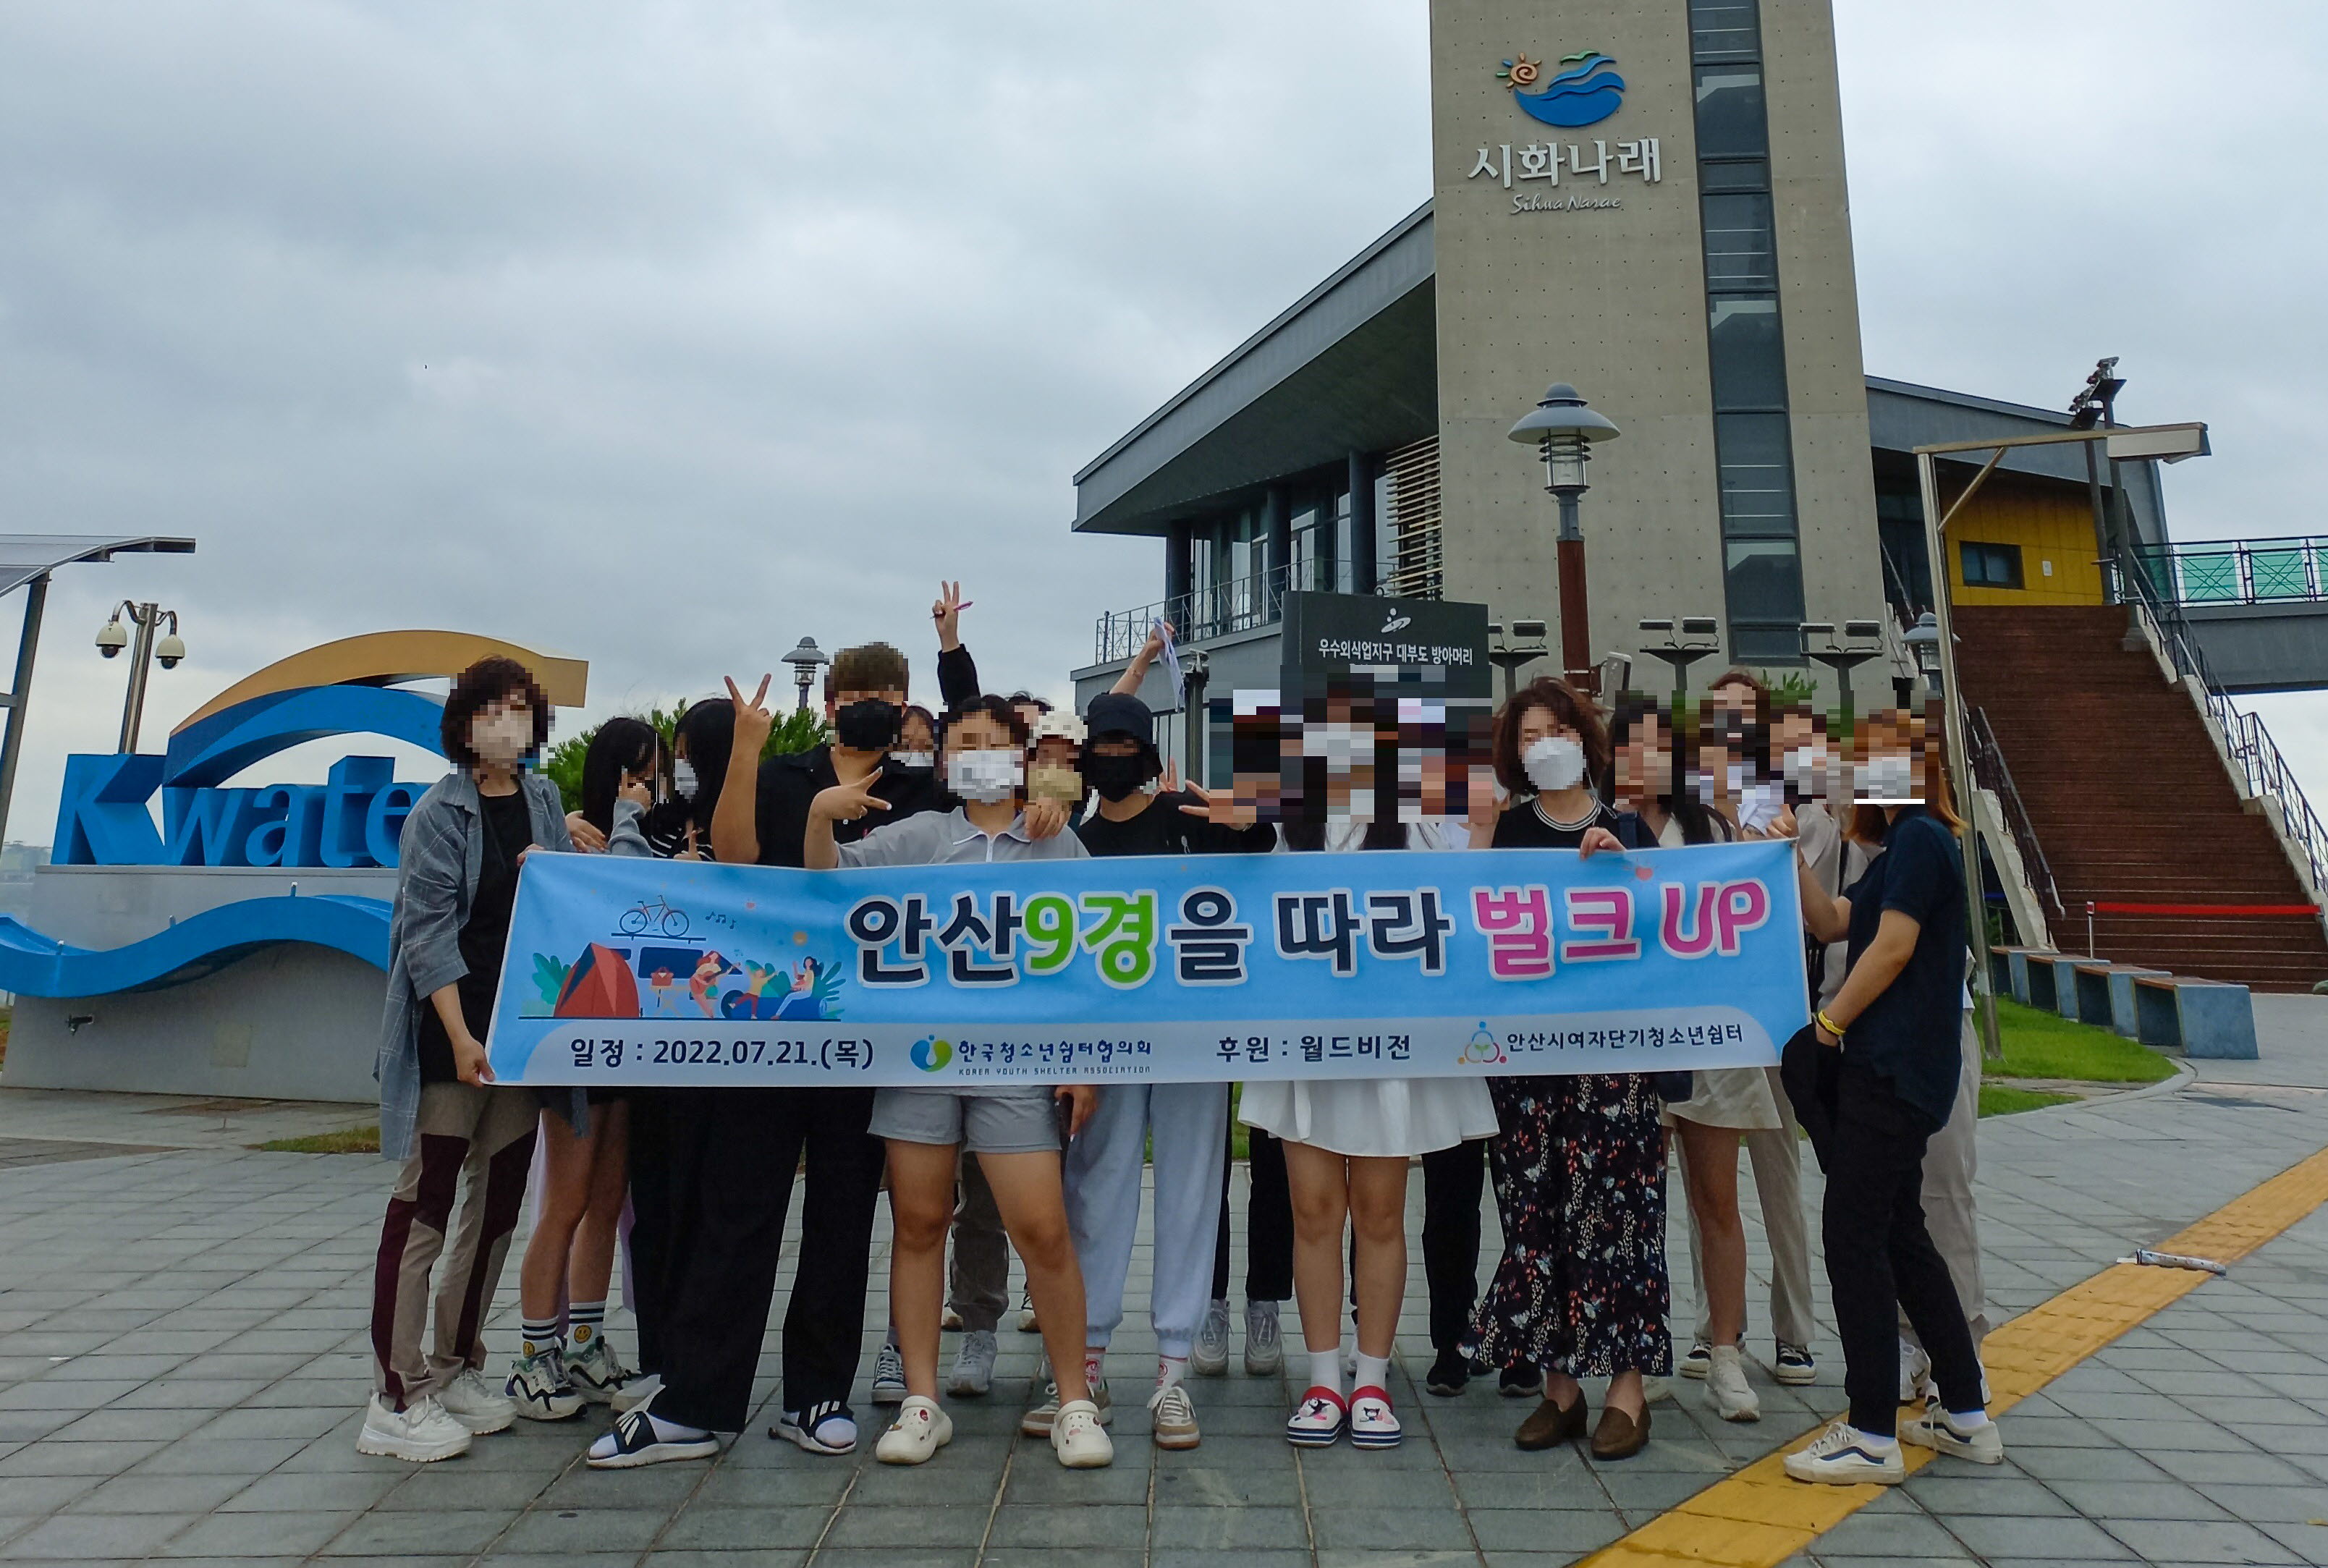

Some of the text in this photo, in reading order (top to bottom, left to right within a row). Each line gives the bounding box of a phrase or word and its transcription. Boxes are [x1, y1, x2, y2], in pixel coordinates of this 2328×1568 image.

[1468, 137, 1662, 190] 시화나래
[1510, 193, 1621, 215] Sihwa Narae
[1319, 638, 1473, 665] 우수외식업지구 대부도 방아머리
[51, 754, 436, 868] Kwate
[1272, 887, 1456, 977] 따라
[1472, 886, 1641, 980] 벌크
[1661, 878, 1770, 958] UP
[958, 1039, 1153, 1064] 한국청소년쉼터협의회
[1216, 1035, 1270, 1063] 후원
[1300, 1034, 1411, 1062] 월드비전
[1507, 1022, 1743, 1053] 안산시여자단기청소년쉼터
[570, 1038, 626, 1068] 일정
[652, 1038, 875, 1070] 2022.07.21.(목)
[996, 1067, 1028, 1076] YOUTH
[1034, 1067, 1078, 1076] SHELTER
[1083, 1065, 1151, 1075] ASSOCIATION
